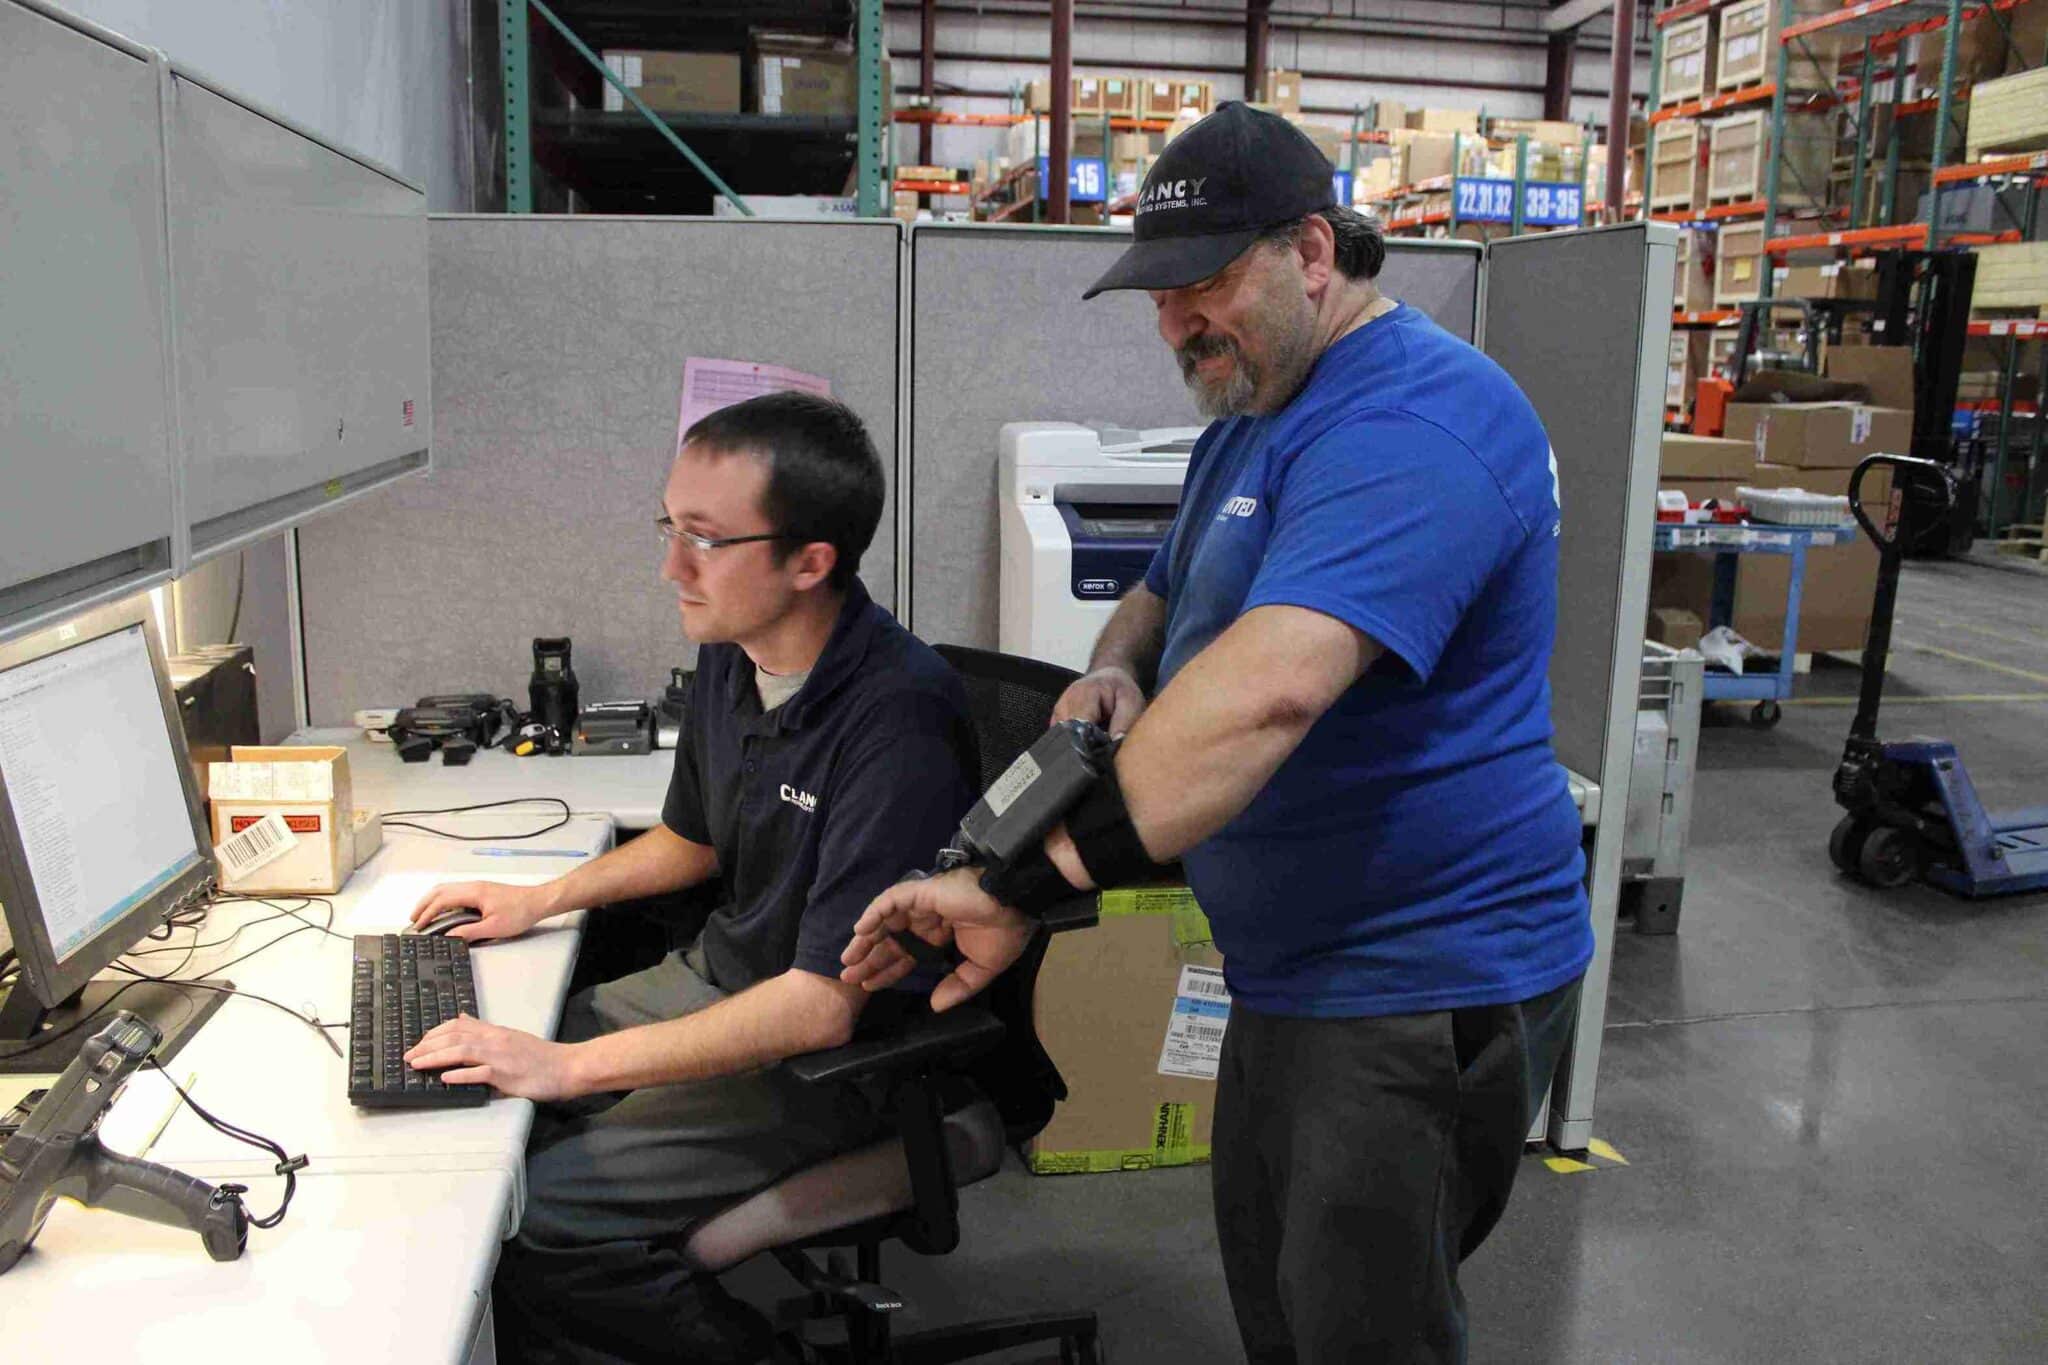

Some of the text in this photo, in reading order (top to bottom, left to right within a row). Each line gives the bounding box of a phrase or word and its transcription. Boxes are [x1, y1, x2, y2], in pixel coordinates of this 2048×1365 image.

[1142, 176, 1207, 204] ANCY
[1459, 183, 1512, 217] 22,31,32
[1527, 187, 1579, 219] 33-35
